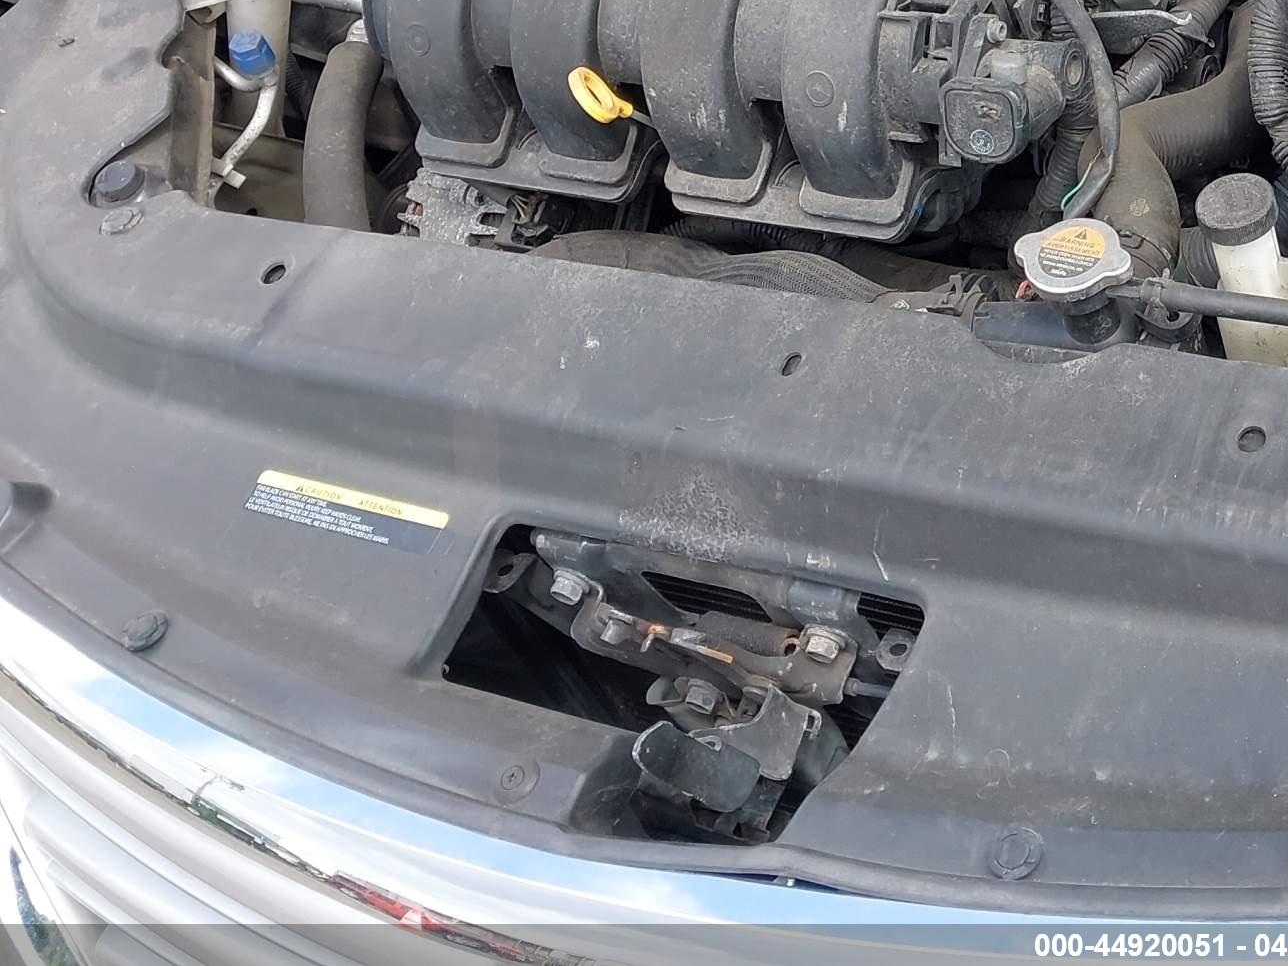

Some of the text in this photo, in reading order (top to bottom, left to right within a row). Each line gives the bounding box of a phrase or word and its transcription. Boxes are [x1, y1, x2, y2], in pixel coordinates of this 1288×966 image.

[1058, 236, 1096, 248] WARNING
[305, 486, 403, 515] CAUTION ATTENTION
